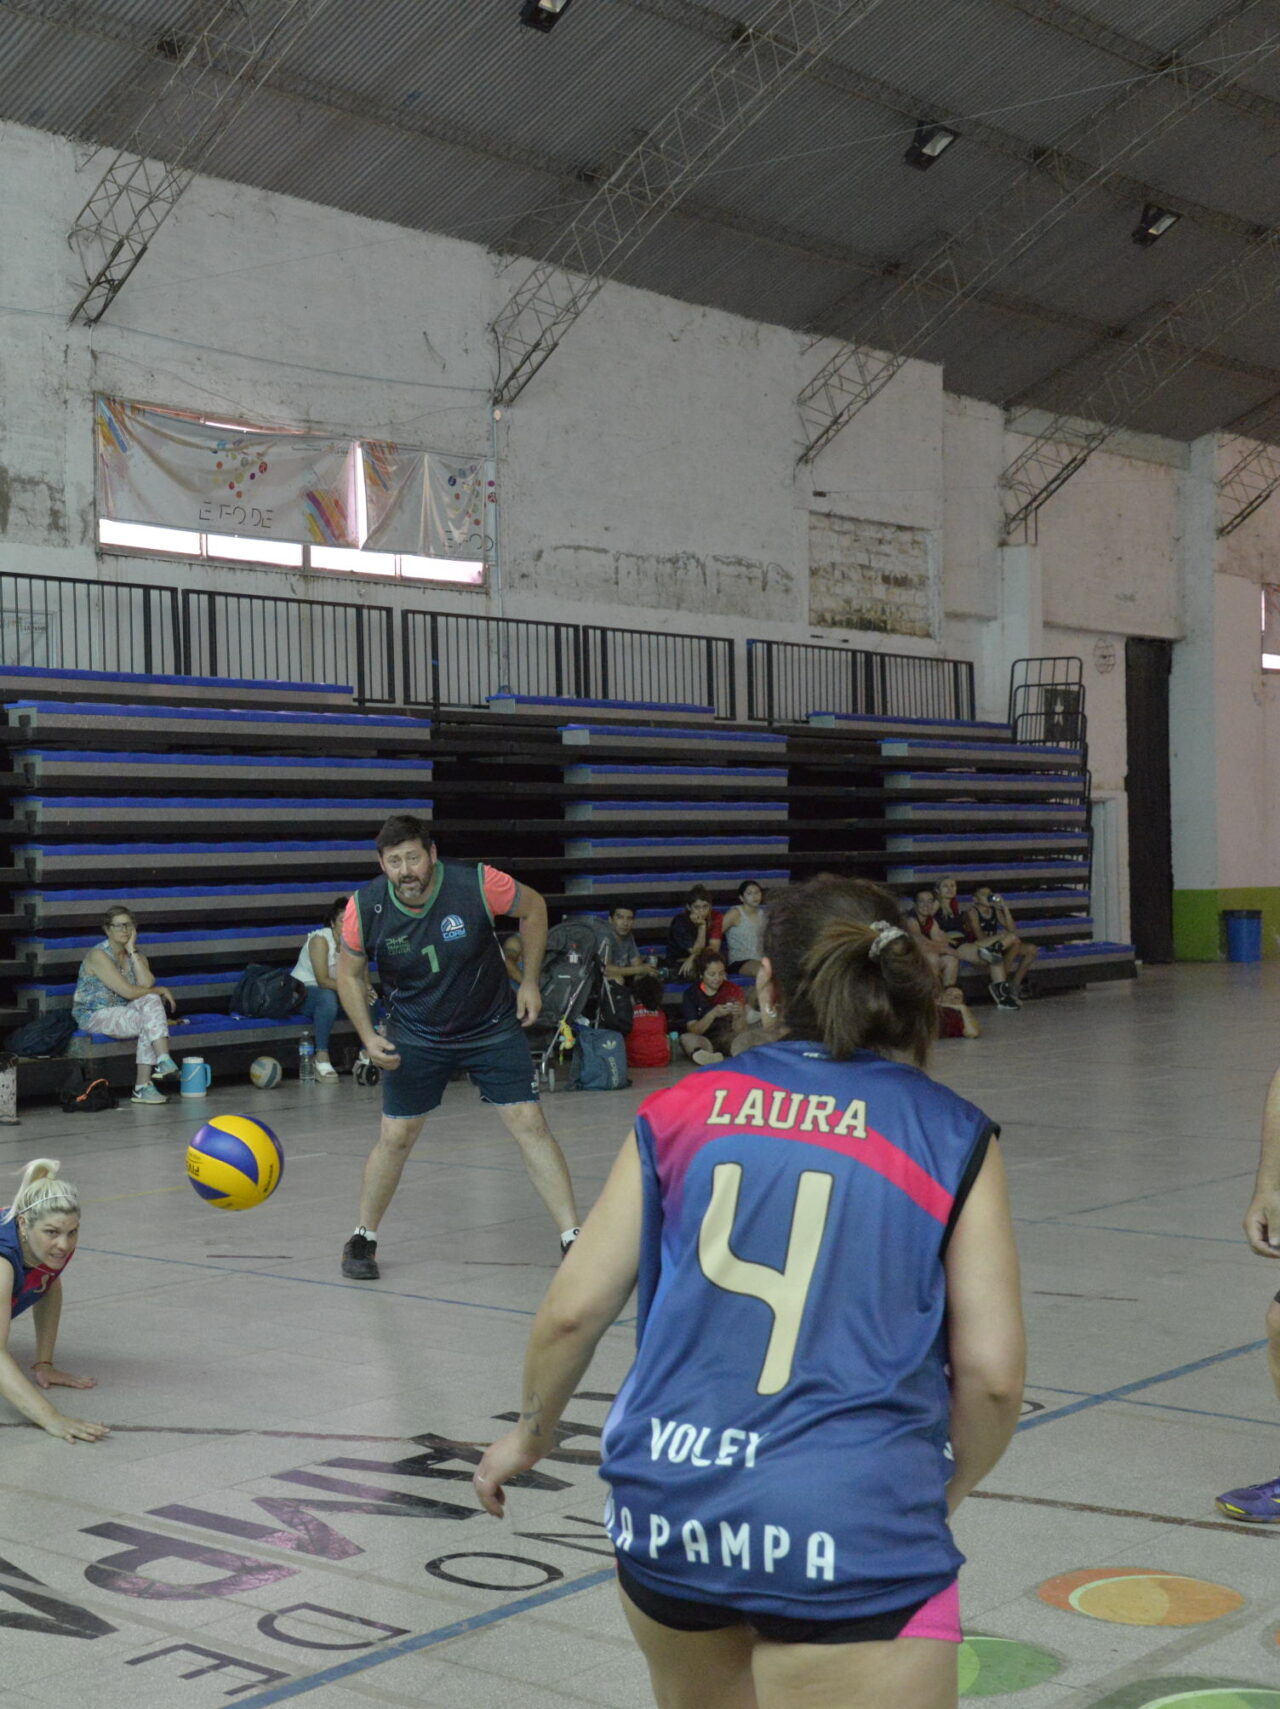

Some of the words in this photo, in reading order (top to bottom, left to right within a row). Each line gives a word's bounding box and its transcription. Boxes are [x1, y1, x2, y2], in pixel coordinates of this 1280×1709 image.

[421, 944, 440, 973] 1
[706, 1087, 868, 1140] LAURA
[697, 1161, 834, 1396] 4
[651, 1417, 768, 1468] VOLEY
[649, 1513, 836, 1581] PAMPA
